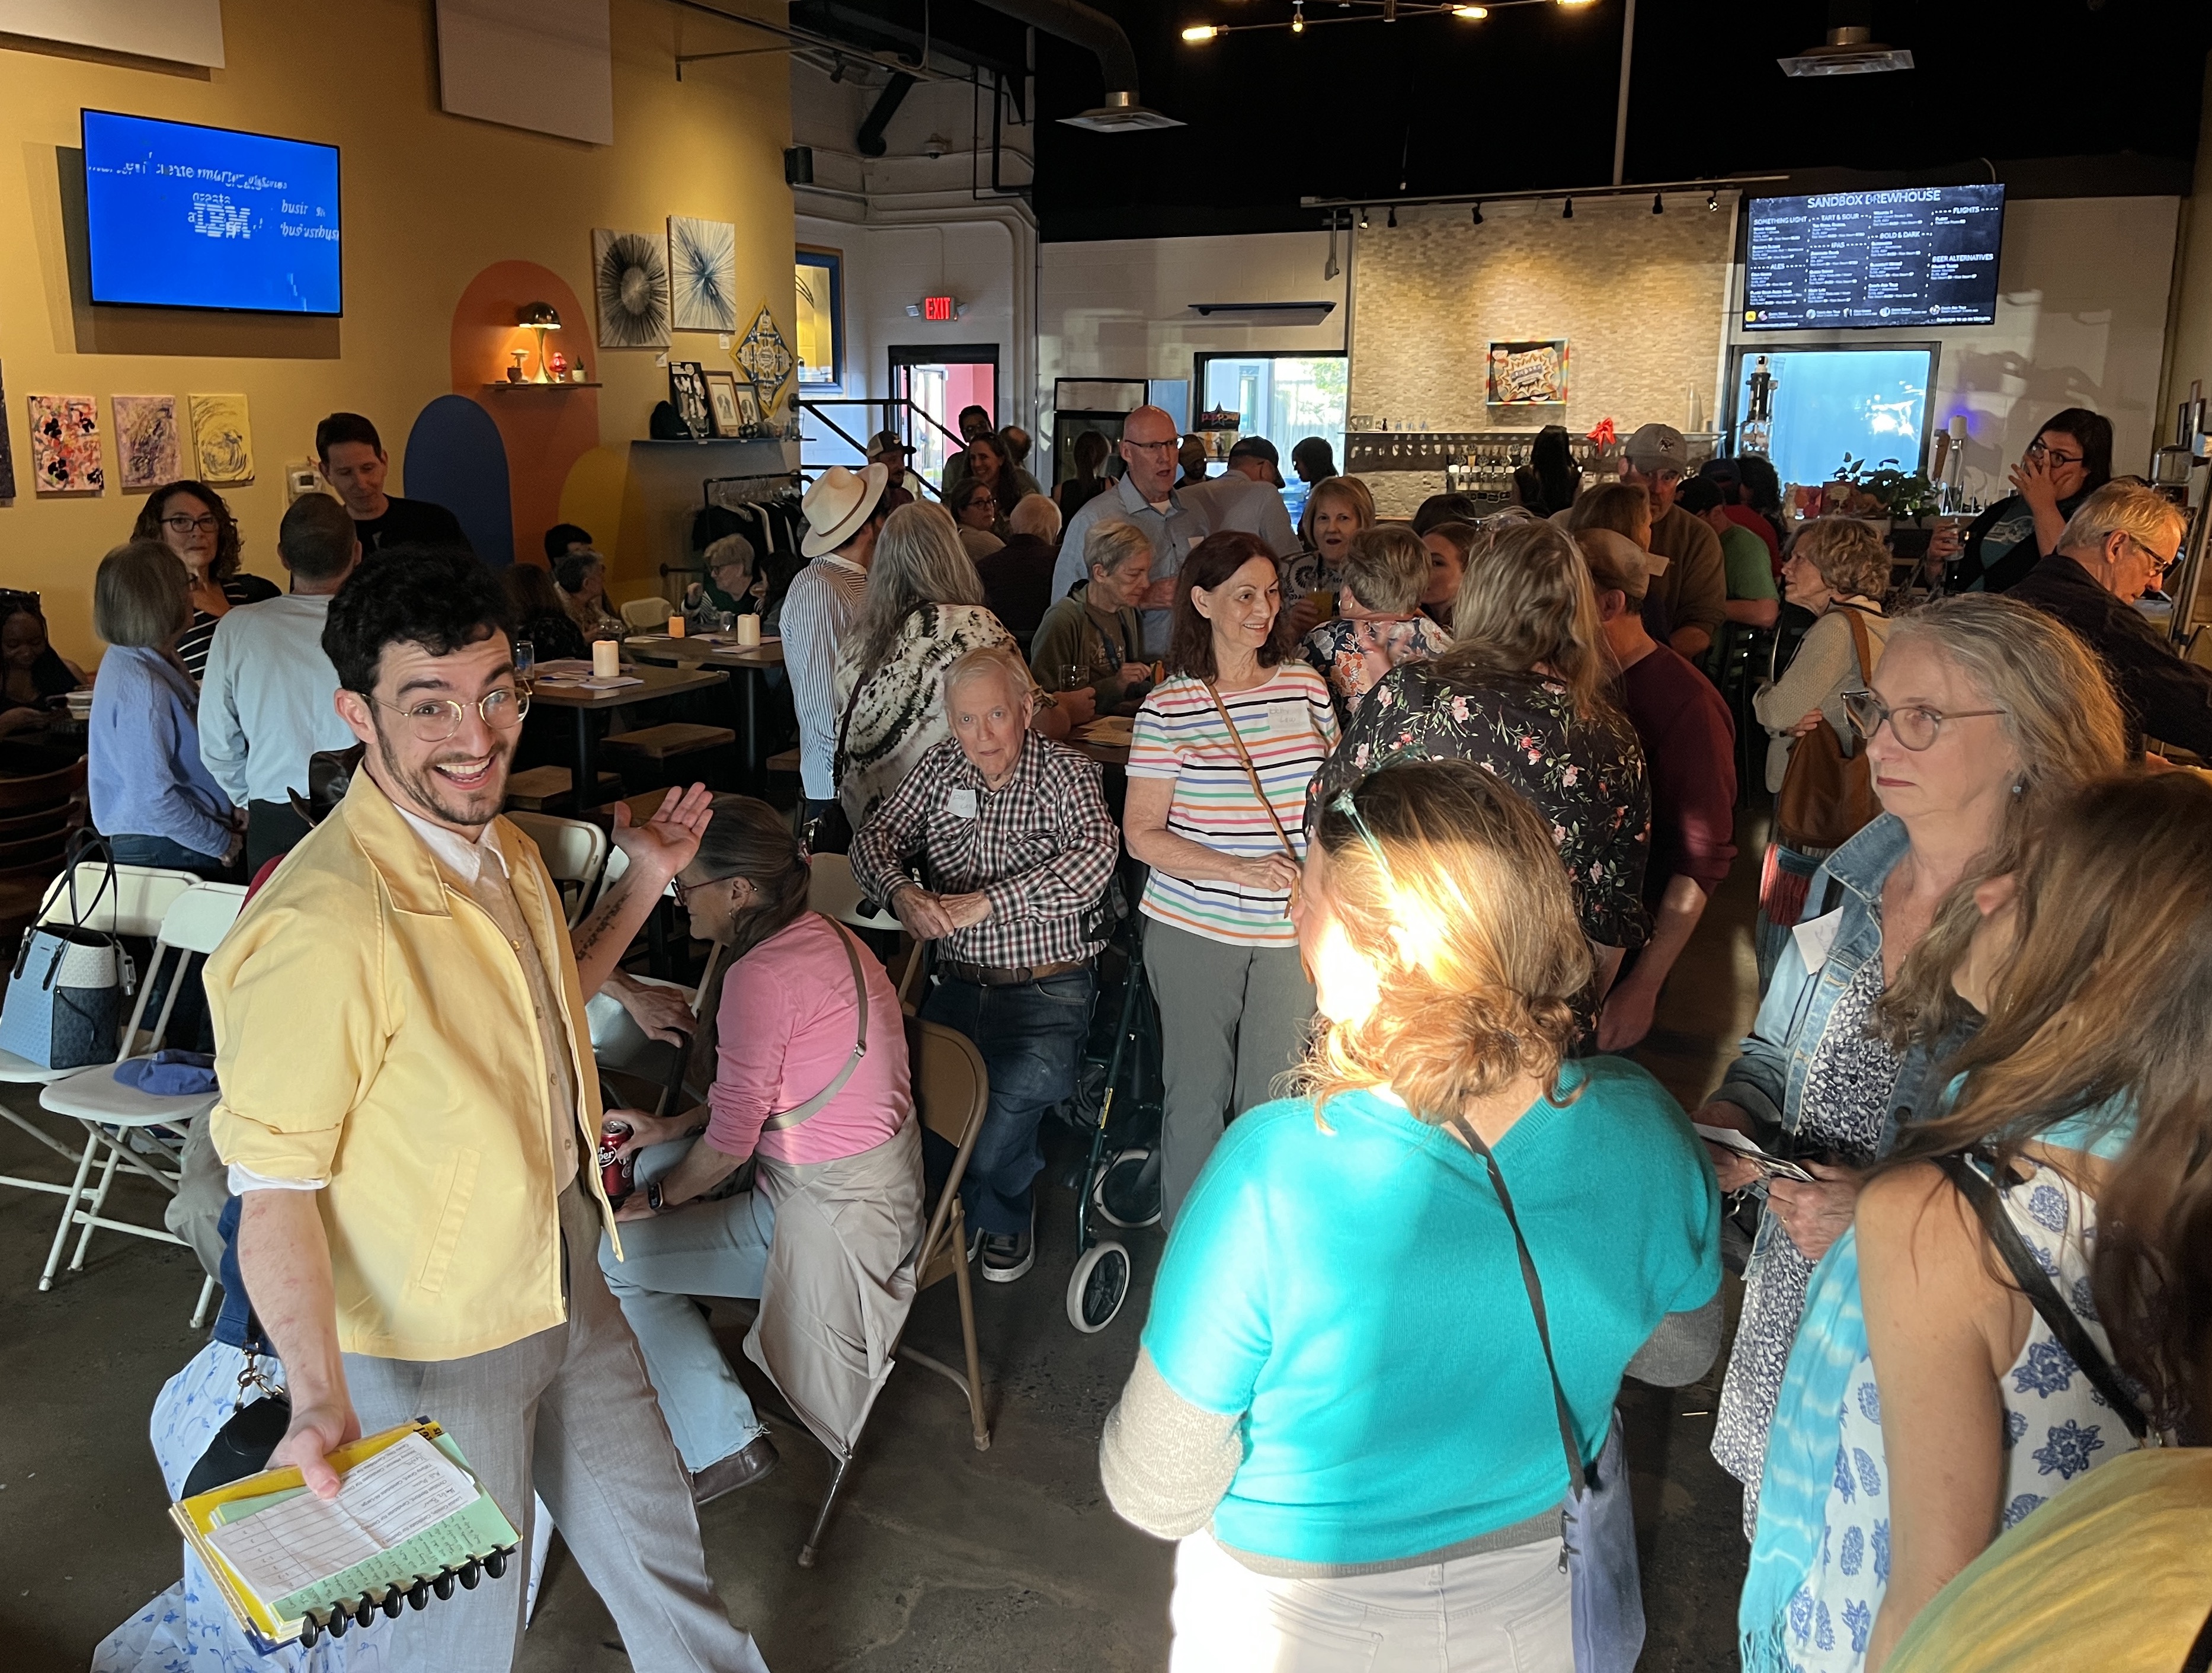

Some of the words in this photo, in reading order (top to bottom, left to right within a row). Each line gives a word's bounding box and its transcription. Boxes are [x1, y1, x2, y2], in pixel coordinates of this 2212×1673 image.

[1807, 194, 1862, 208] SANDBOX
[1865, 190, 1941, 204] BREWHOUSE
[1949, 253, 1994, 261] ALTERNATIVES
[925, 297, 950, 320] EXIT
